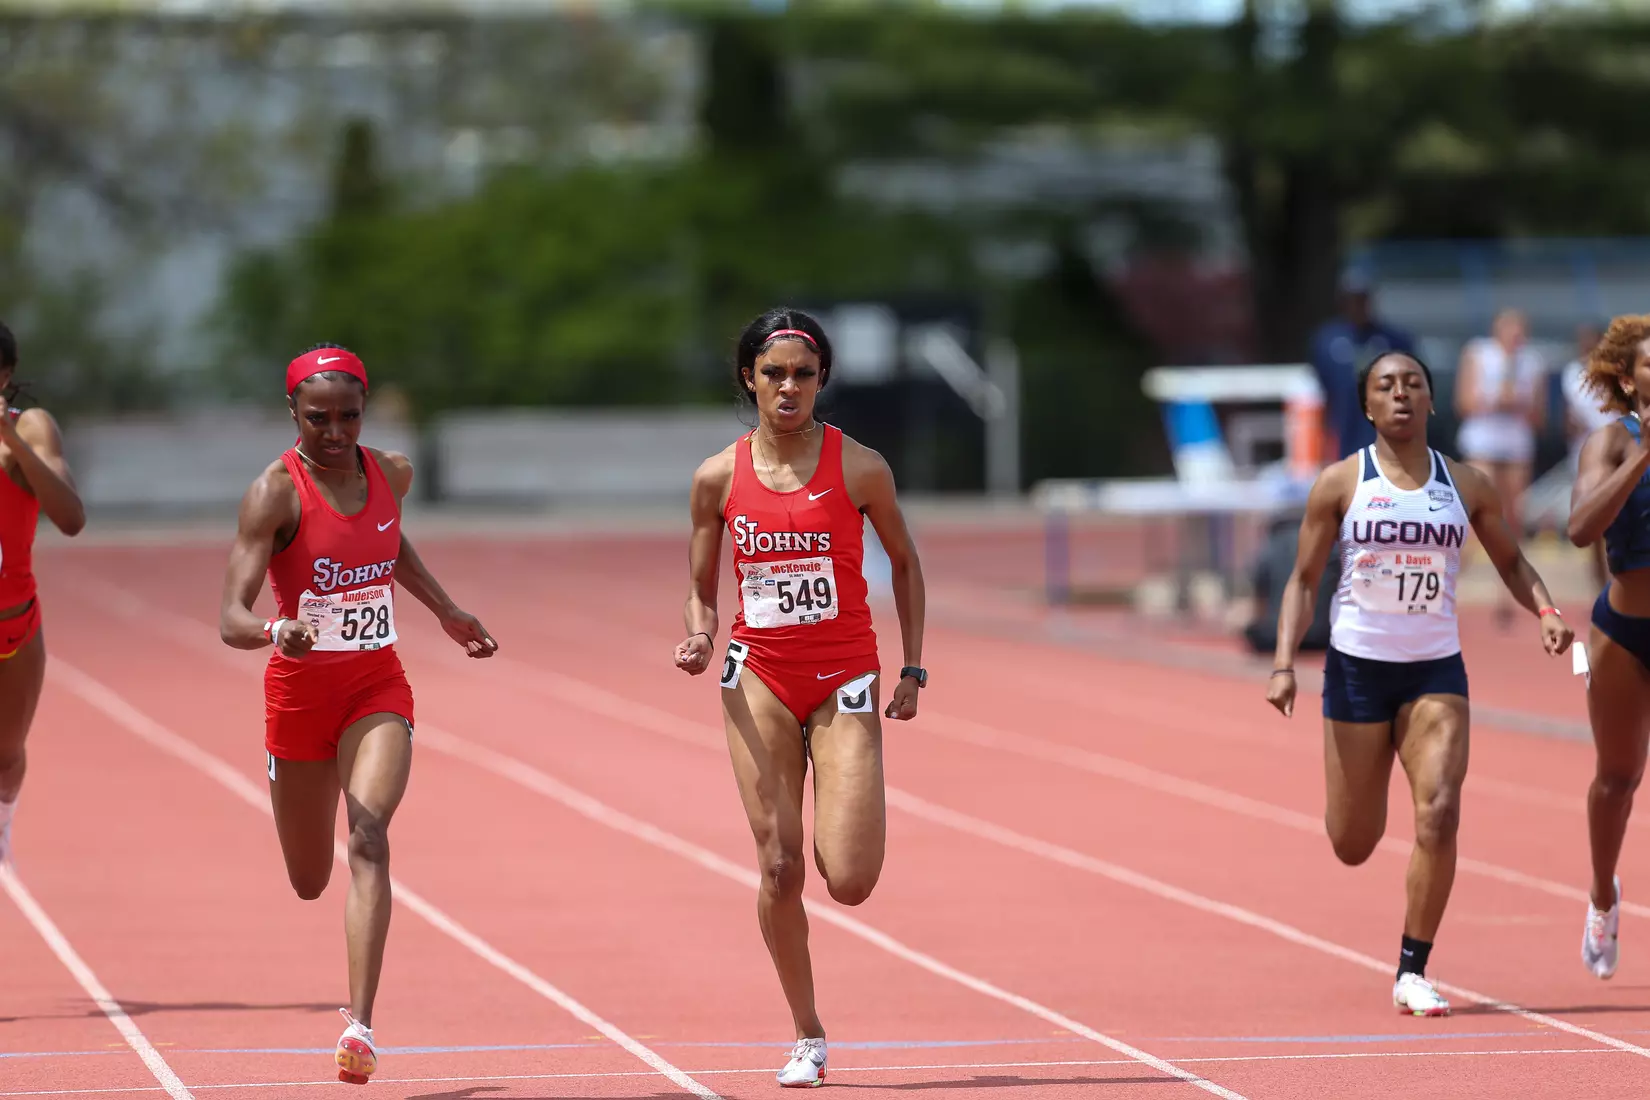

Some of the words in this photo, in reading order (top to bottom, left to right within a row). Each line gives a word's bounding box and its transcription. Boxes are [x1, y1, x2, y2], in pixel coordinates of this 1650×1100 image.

[1352, 520, 1465, 549] UCONN
[770, 561, 822, 575] McKenzie
[1406, 553, 1433, 565] Davis
[341, 588, 386, 603] Anderson
[776, 576, 833, 615] 549
[1394, 571, 1440, 602] 179
[340, 604, 390, 642] 528
